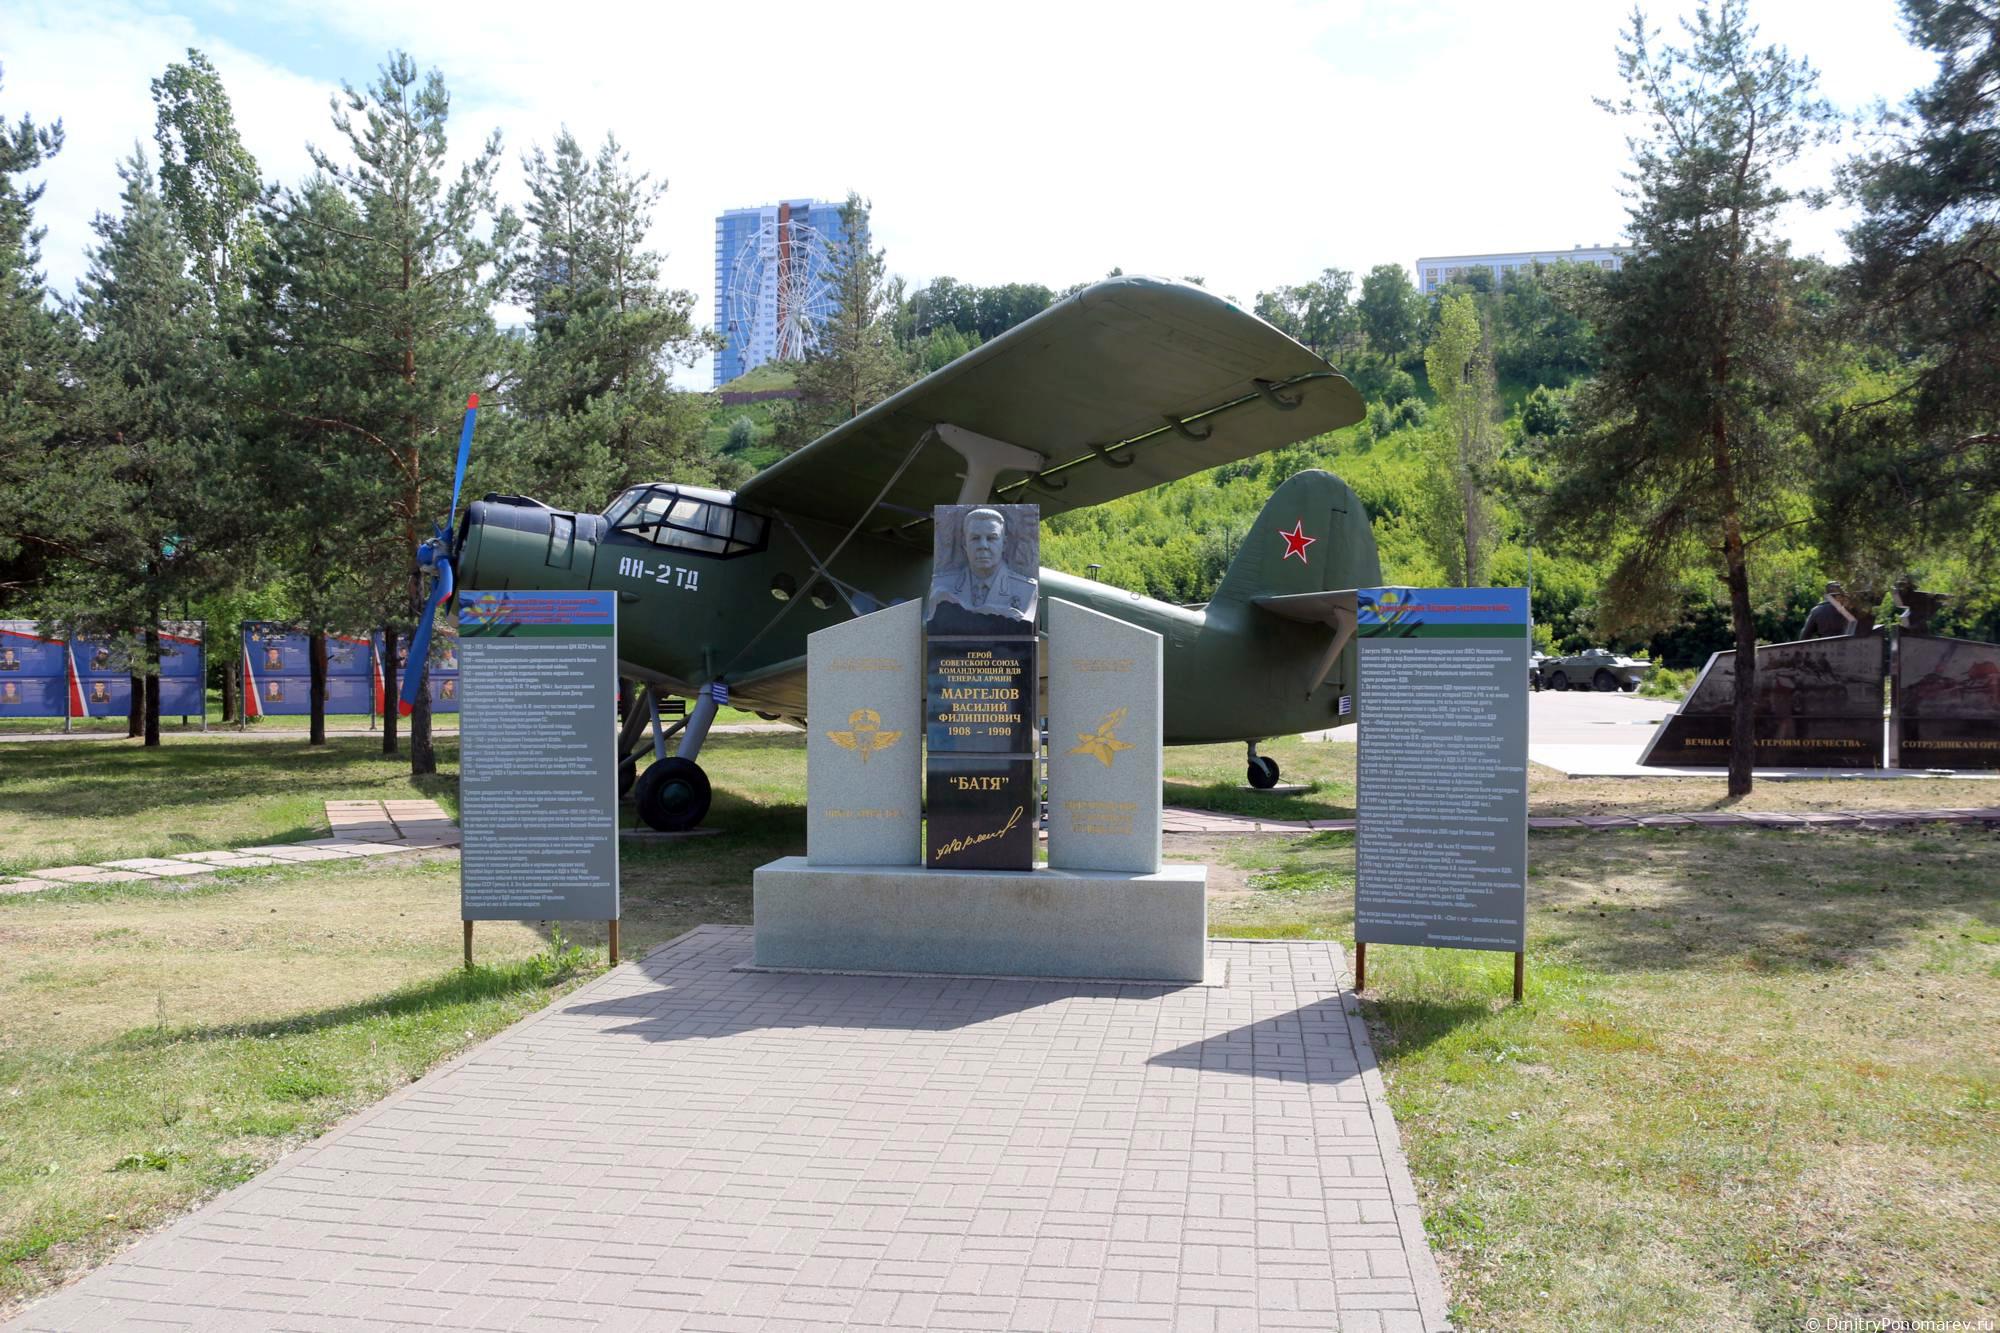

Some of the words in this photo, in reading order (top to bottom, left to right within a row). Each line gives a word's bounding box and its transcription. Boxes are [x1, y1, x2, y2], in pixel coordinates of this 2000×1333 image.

[967, 651, 992, 659] ГЕРОЙ
[941, 688, 1020, 700] МАРГЕЛОВ
[952, 702, 1007, 712] ВАСИЛИЙ
[938, 714, 1021, 723] ФИЛИППОВИЧ
[948, 727, 971, 736] 1908
[988, 727, 1011, 736] 1990
[1685, 738, 1724, 746] ВЕЧНАЯ
[1761, 739, 1801, 747] ГЕРОЯМ
[1802, 739, 1860, 748] ОТЕЧЕСТВА
[1902, 740, 1977, 749] СОТРУДНИКАМ
